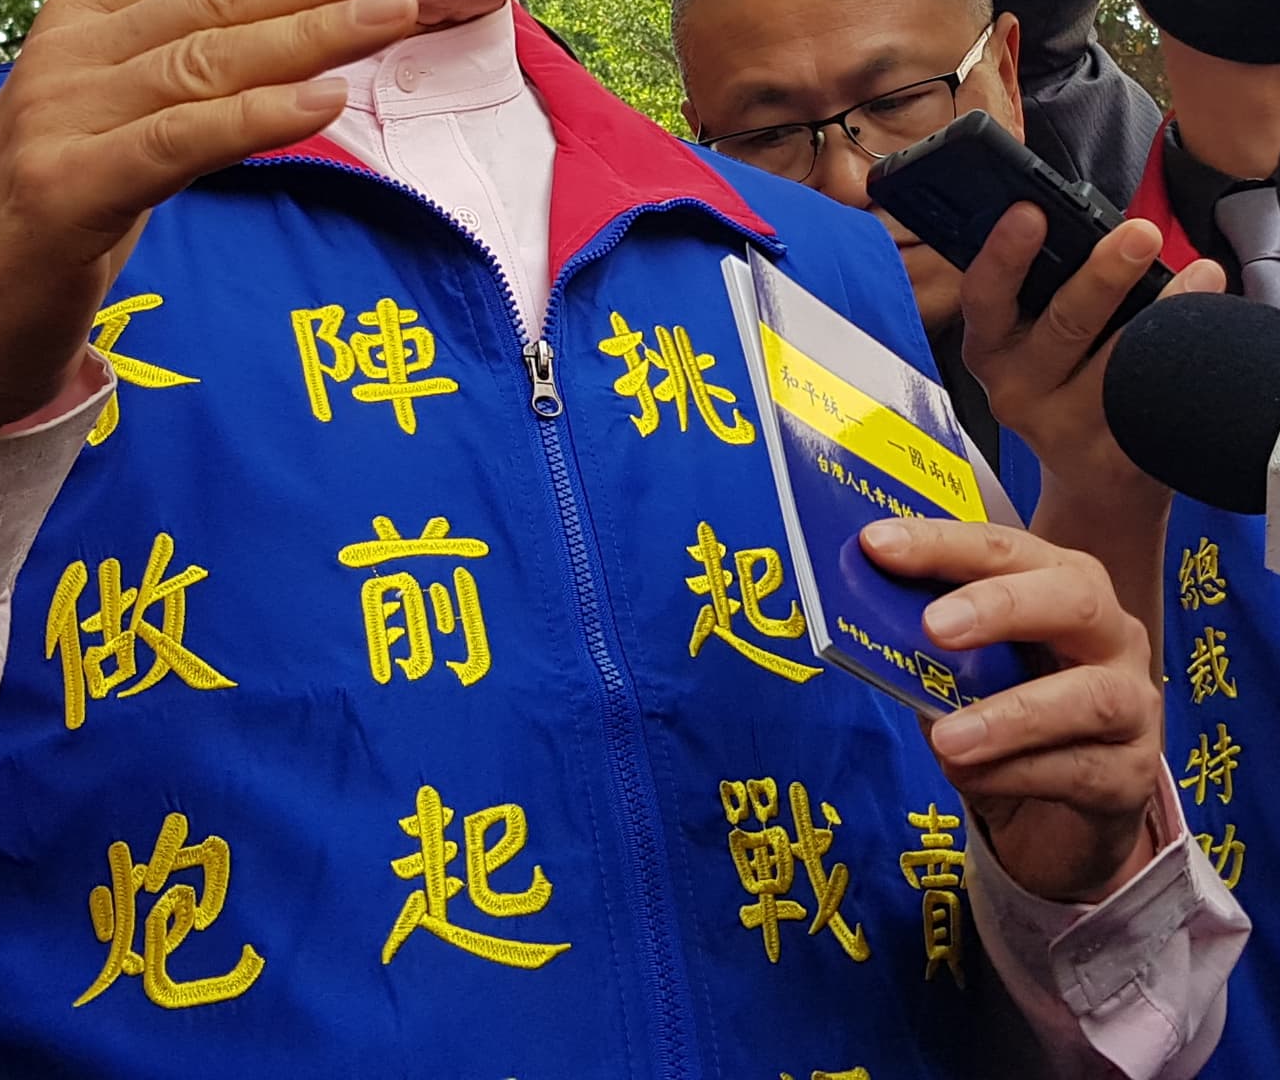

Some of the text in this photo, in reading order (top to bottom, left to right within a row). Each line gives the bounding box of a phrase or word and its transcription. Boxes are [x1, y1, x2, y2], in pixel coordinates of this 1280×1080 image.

[291, 298, 571, 968] 陣前起
[598, 311, 869, 1080] 挑起戰
